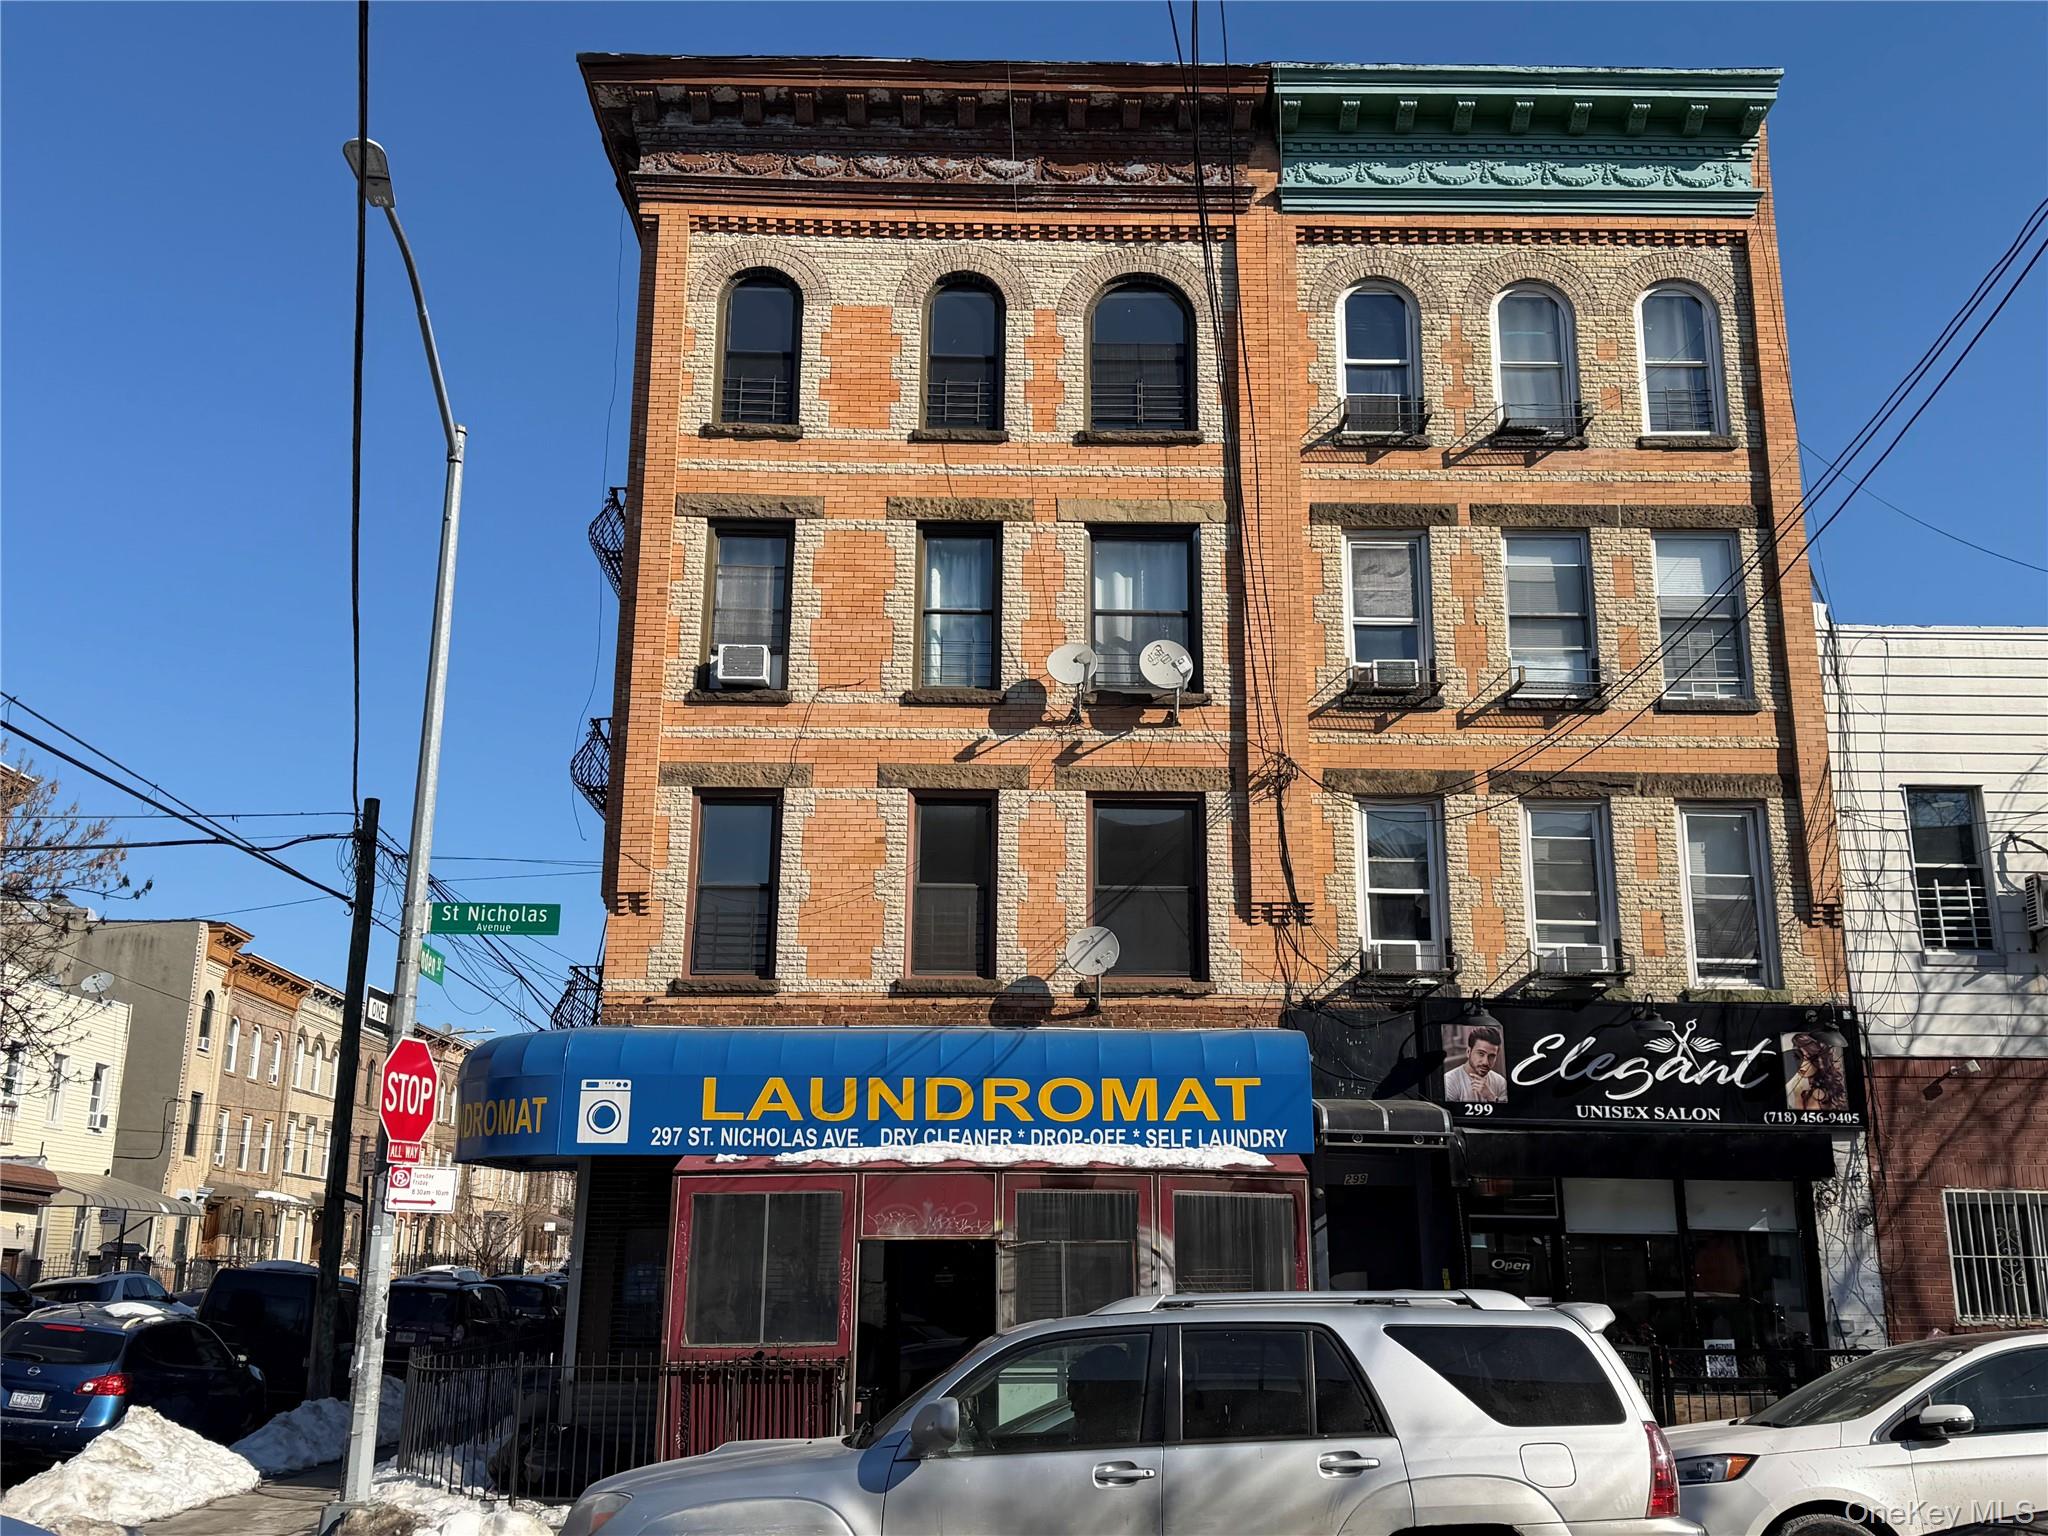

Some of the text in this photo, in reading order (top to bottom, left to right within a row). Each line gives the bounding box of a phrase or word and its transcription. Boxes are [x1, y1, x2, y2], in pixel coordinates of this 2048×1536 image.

[442, 905, 548, 922] St Nicholas
[476, 922, 512, 932] Avenue
[371, 1001, 386, 1021] ONE
[1510, 1033, 1777, 1100] Elegant
[385, 1071, 433, 1115] STOP
[702, 1077, 1261, 1122] LAUNDROMAT
[1464, 1103, 1494, 1116] 299
[1576, 1104, 1721, 1121] UNISEX SALON
[1763, 1111, 1860, 1125] (718) 456-9405
[651, 1127, 1288, 1148] 297 ST. NICHOLAS AVE. DRY CLEANER DROP-OFF SELF LAUNDRY
[390, 1145, 418, 1159] ALL WAY
[412, 1179, 429, 1187] Friday
[413, 1172, 435, 1180] Tuesday
[1344, 1174, 1368, 1185] 299
[411, 1188, 431, 1196] 830am
[435, 1188, 450, 1197] 10am
[1491, 1258, 1531, 1271] Open
